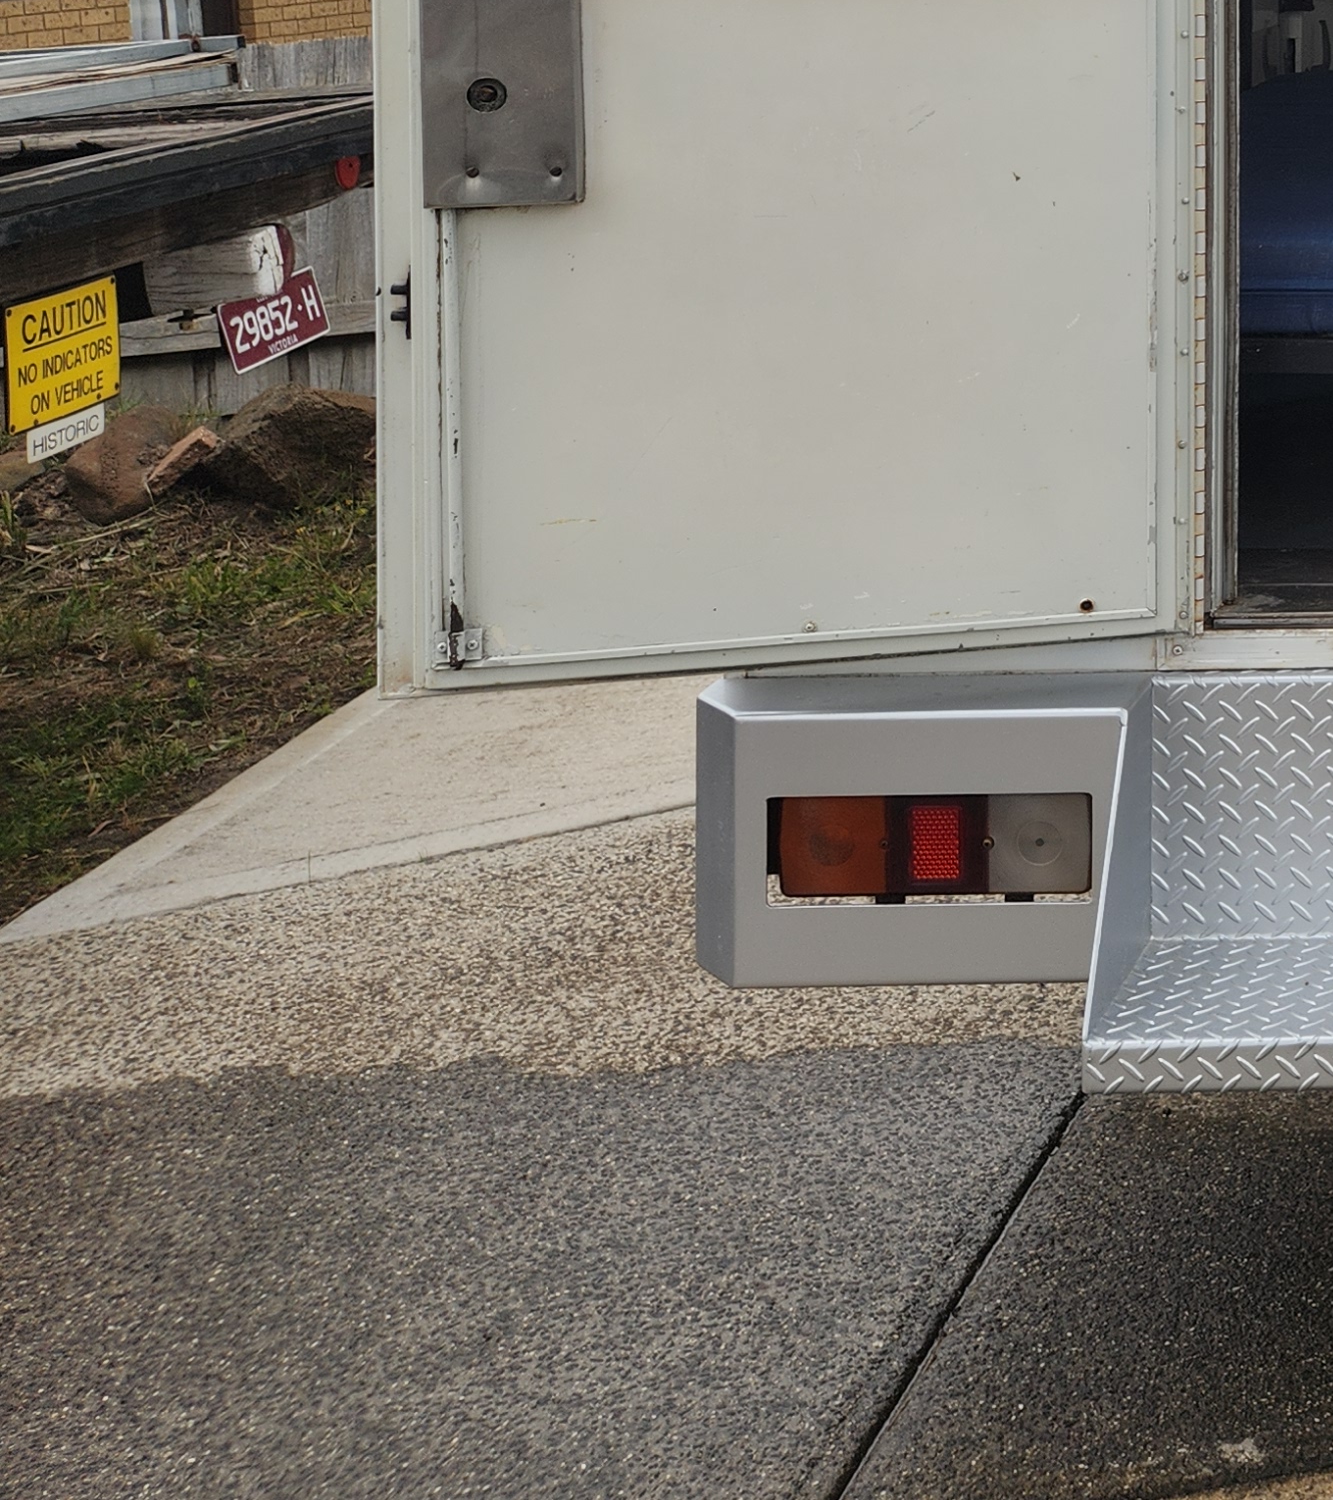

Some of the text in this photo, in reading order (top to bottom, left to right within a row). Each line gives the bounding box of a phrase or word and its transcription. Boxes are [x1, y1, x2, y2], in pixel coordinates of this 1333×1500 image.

[22, 290, 107, 345] CAUTION
[18, 336, 113, 388] NO INDICATORS
[267, 333, 299, 355] VICTORIA
[30, 370, 104, 416] ON VEHICLE
[32, 414, 100, 457] HISTORIC
